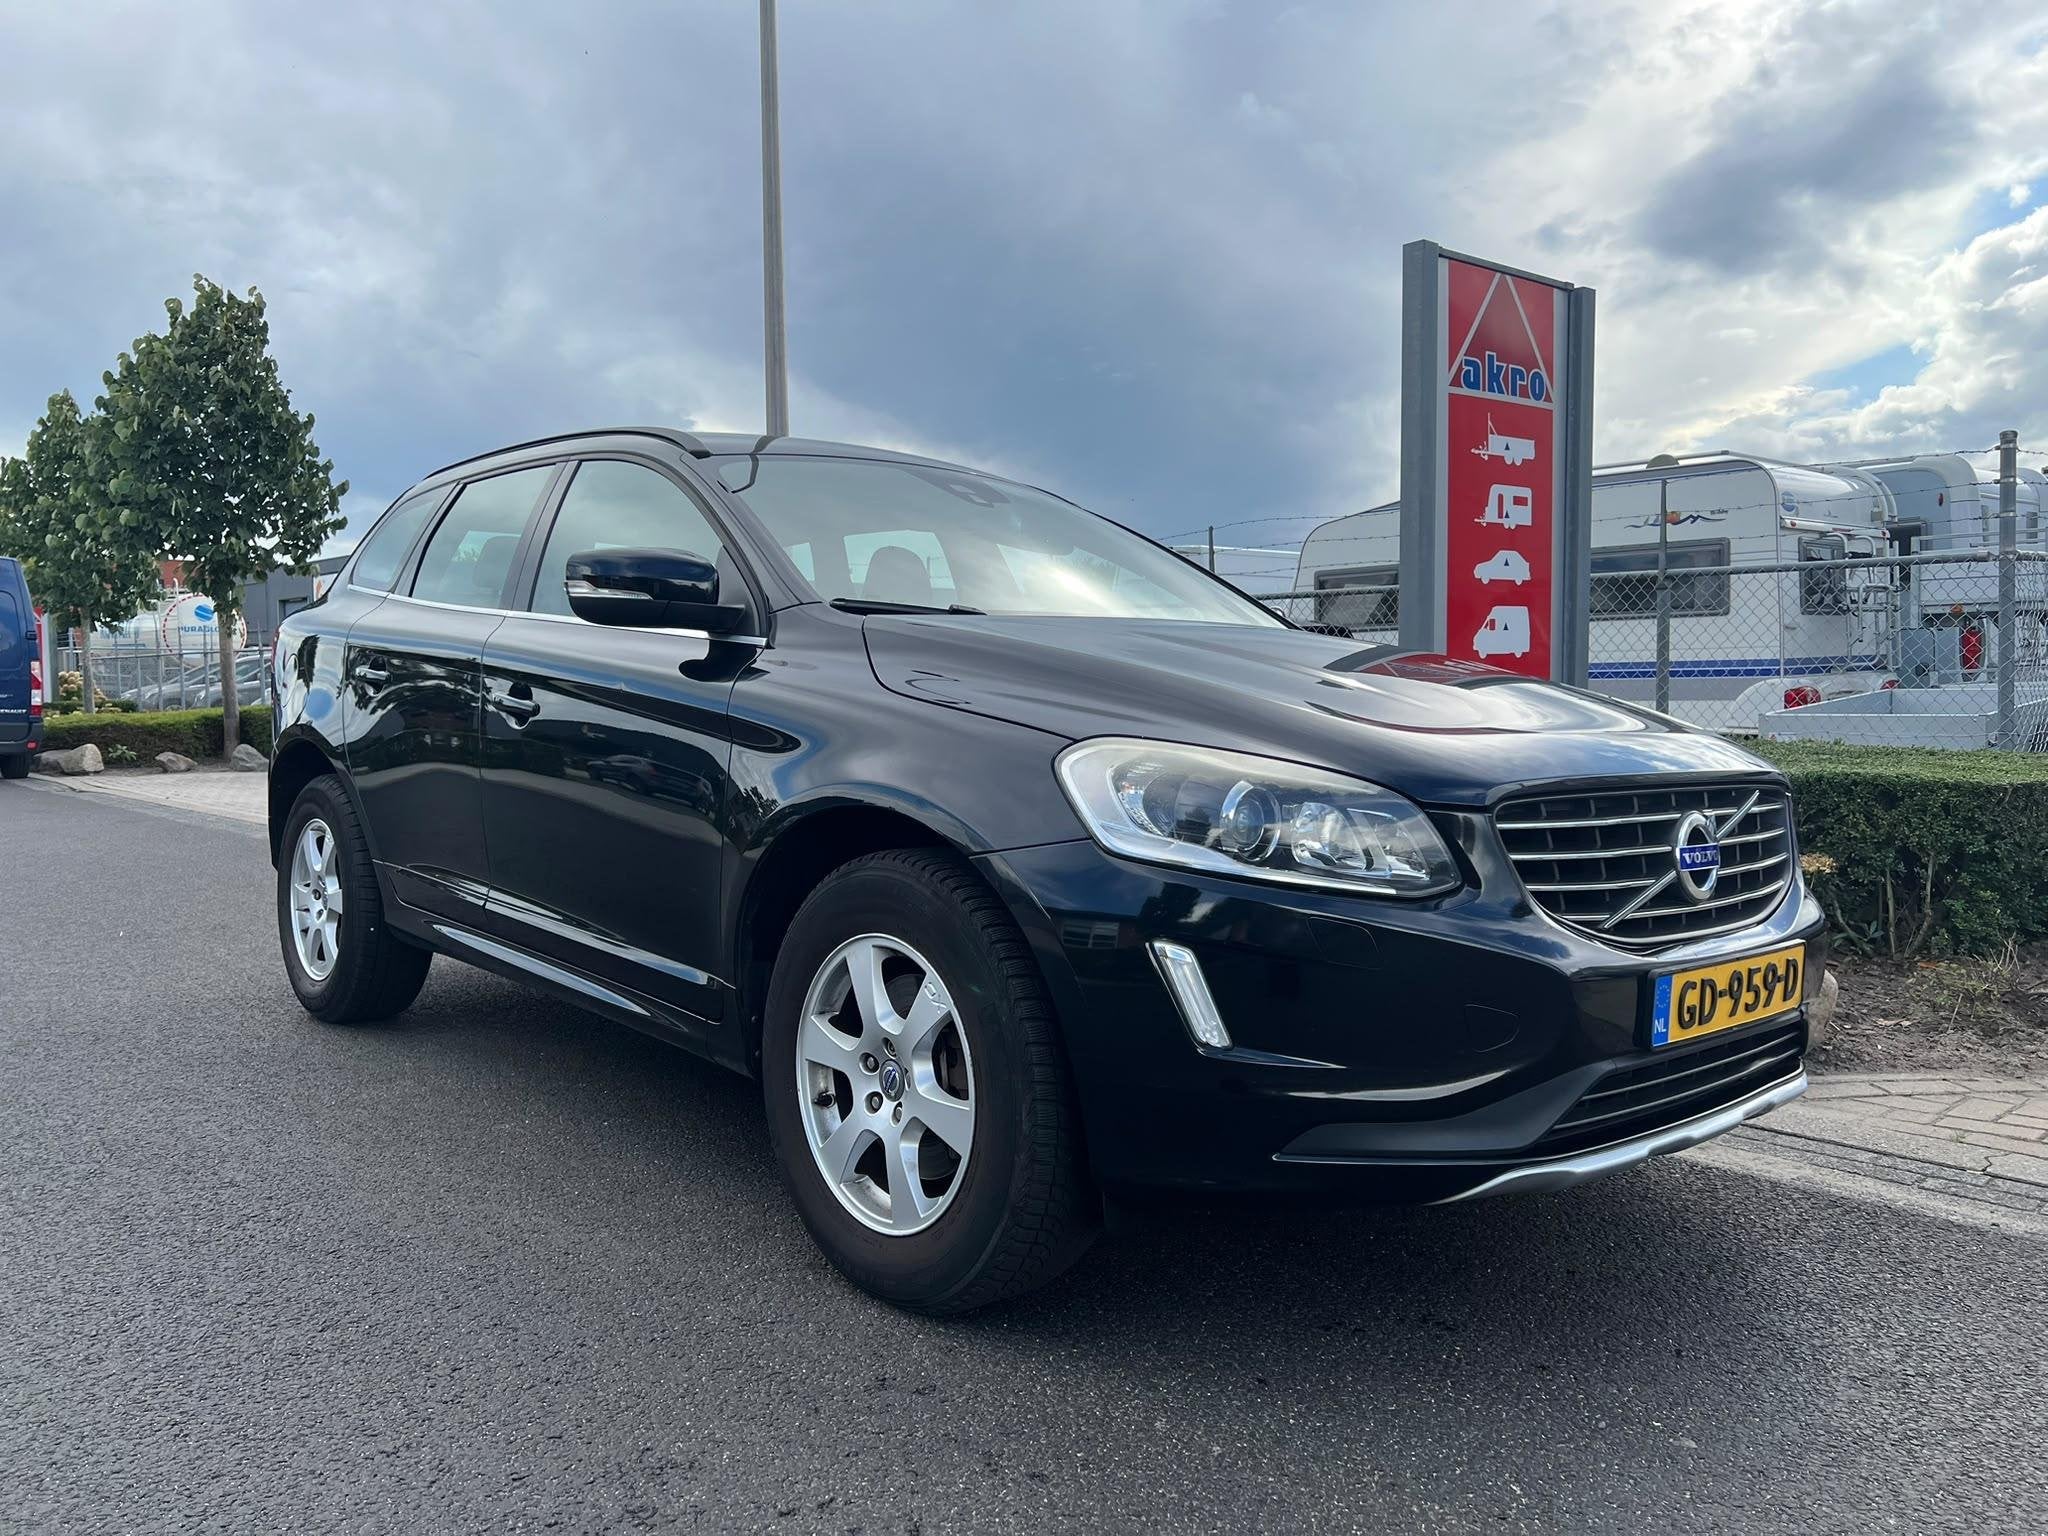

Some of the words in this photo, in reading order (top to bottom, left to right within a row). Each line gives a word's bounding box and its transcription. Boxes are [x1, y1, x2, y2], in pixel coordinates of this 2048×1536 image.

[1461, 352, 1546, 401] akro
[1677, 958, 1799, 1030] GD-959-D
[1654, 1016, 1667, 1034] NL
